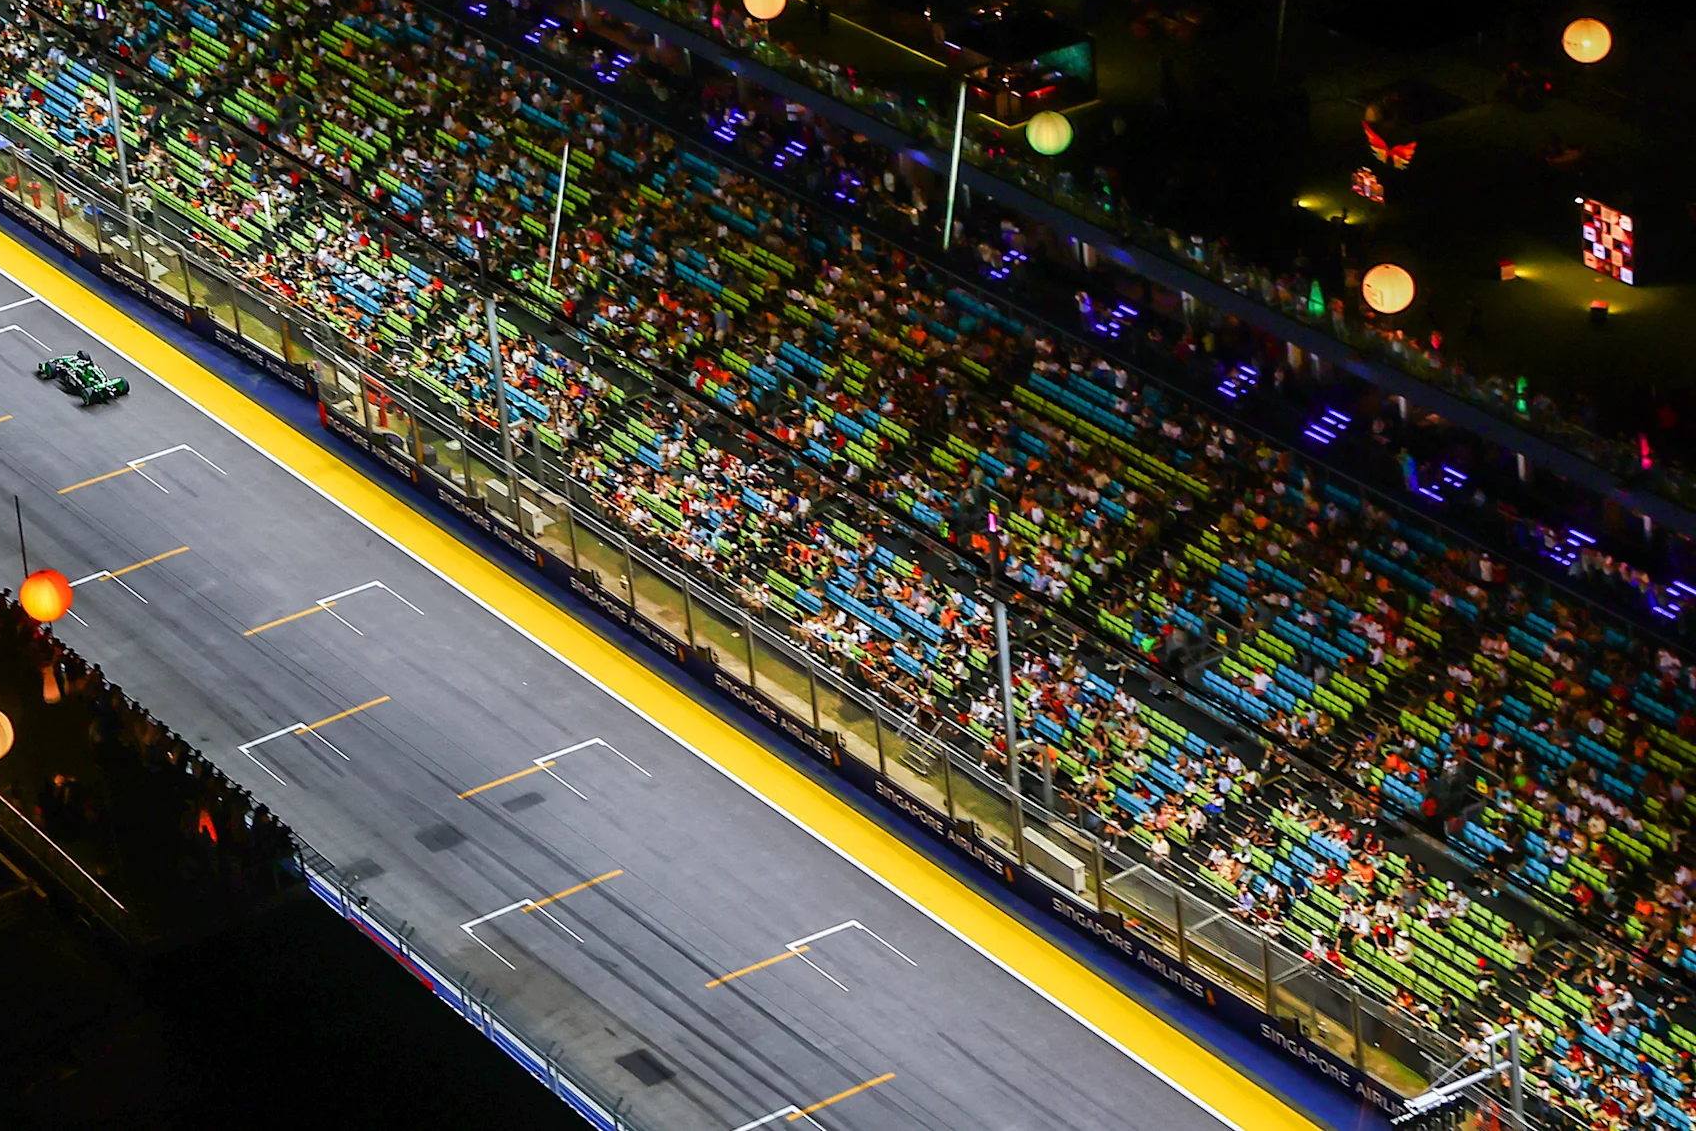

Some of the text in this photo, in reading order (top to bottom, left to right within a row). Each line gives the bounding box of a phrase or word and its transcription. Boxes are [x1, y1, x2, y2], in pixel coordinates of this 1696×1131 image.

[1052, 896, 1204, 998] SINGAPORE AIRLINES
[1260, 1023, 1351, 1088] SINGAPORE
